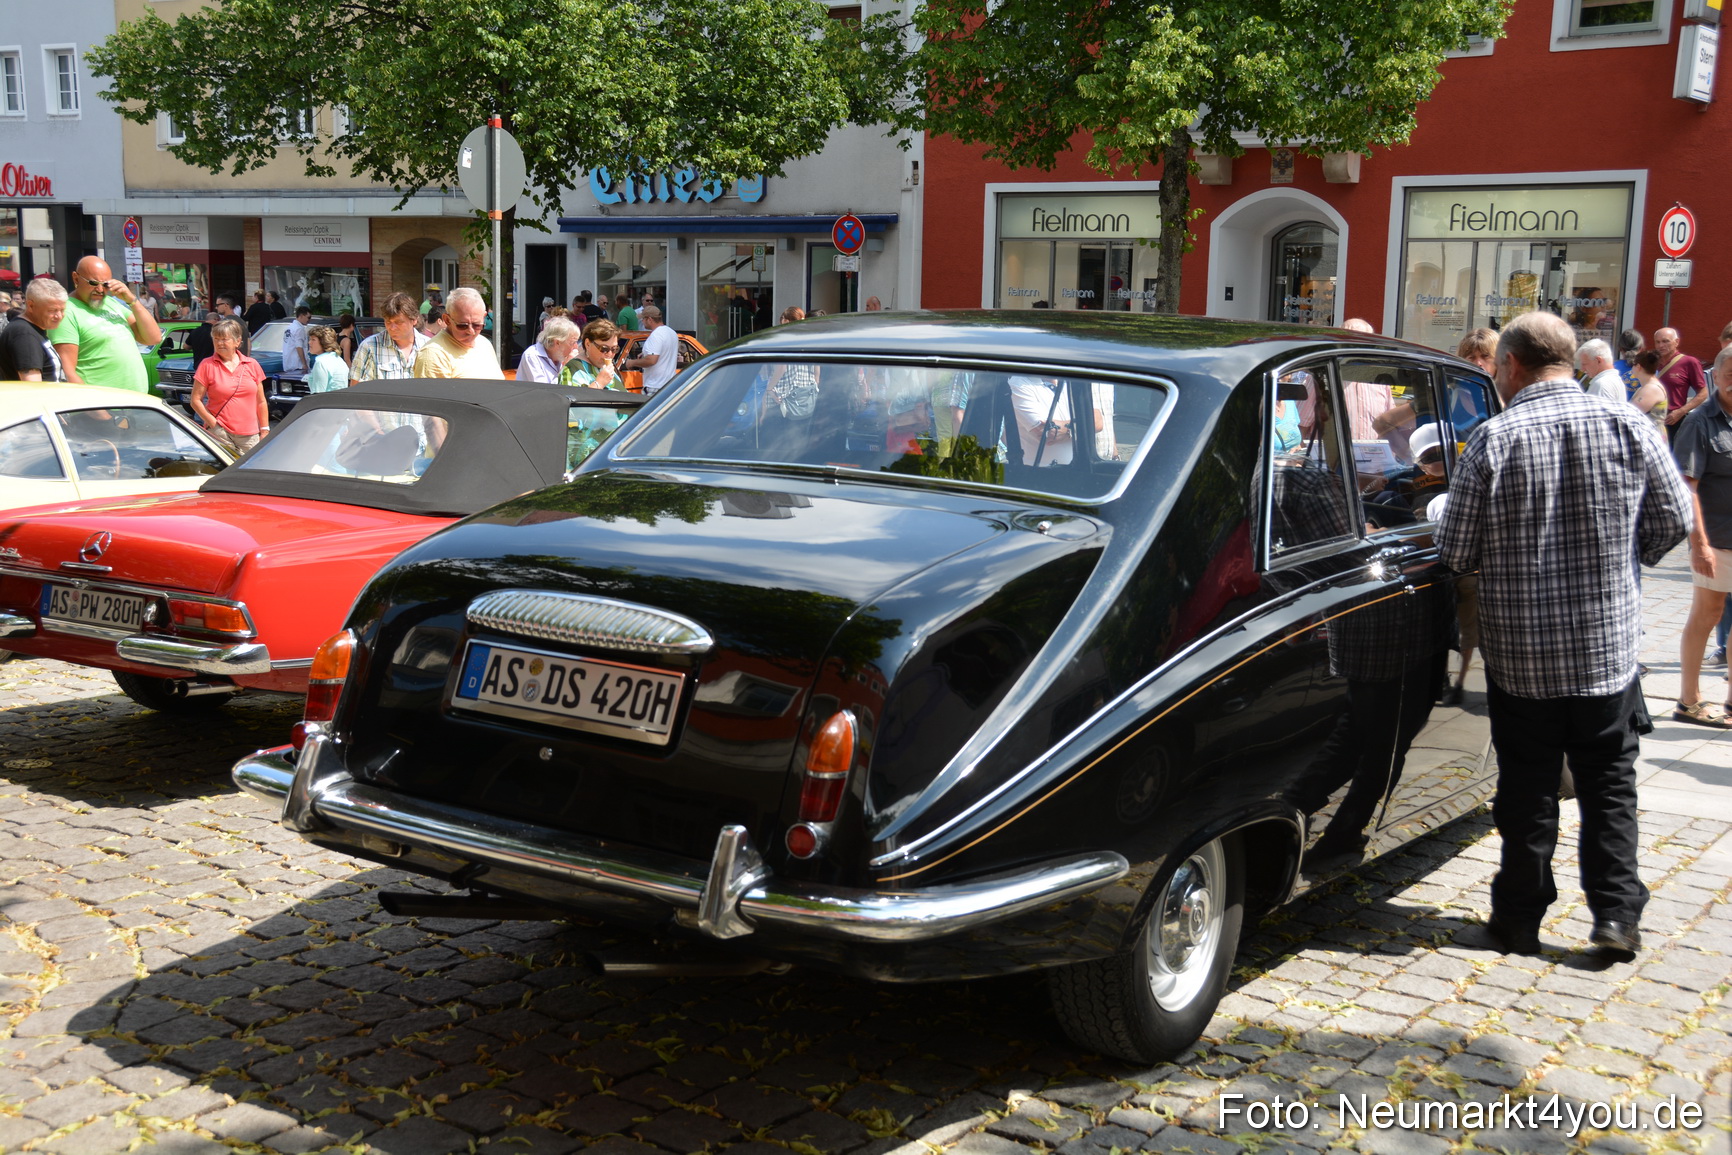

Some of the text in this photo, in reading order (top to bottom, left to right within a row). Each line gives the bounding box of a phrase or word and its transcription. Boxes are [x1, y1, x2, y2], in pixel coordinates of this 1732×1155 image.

[0, 162, 54, 197] .Oliver
[149, 223, 190, 233] Reissinger Optik
[1032, 207, 1130, 232] fielmann
[1449, 203, 1579, 232] fielmann
[175, 235, 200, 243] CENTRUM
[284, 225, 329, 235] Reissinger Optik
[313, 237, 341, 245] CENTRUM
[1669, 221, 1687, 244] 10
[50, 589, 70, 615] AS
[79, 593, 100, 619] PW
[102, 596, 142, 626] 280H
[468, 654, 677, 726] D AS DS 420H
